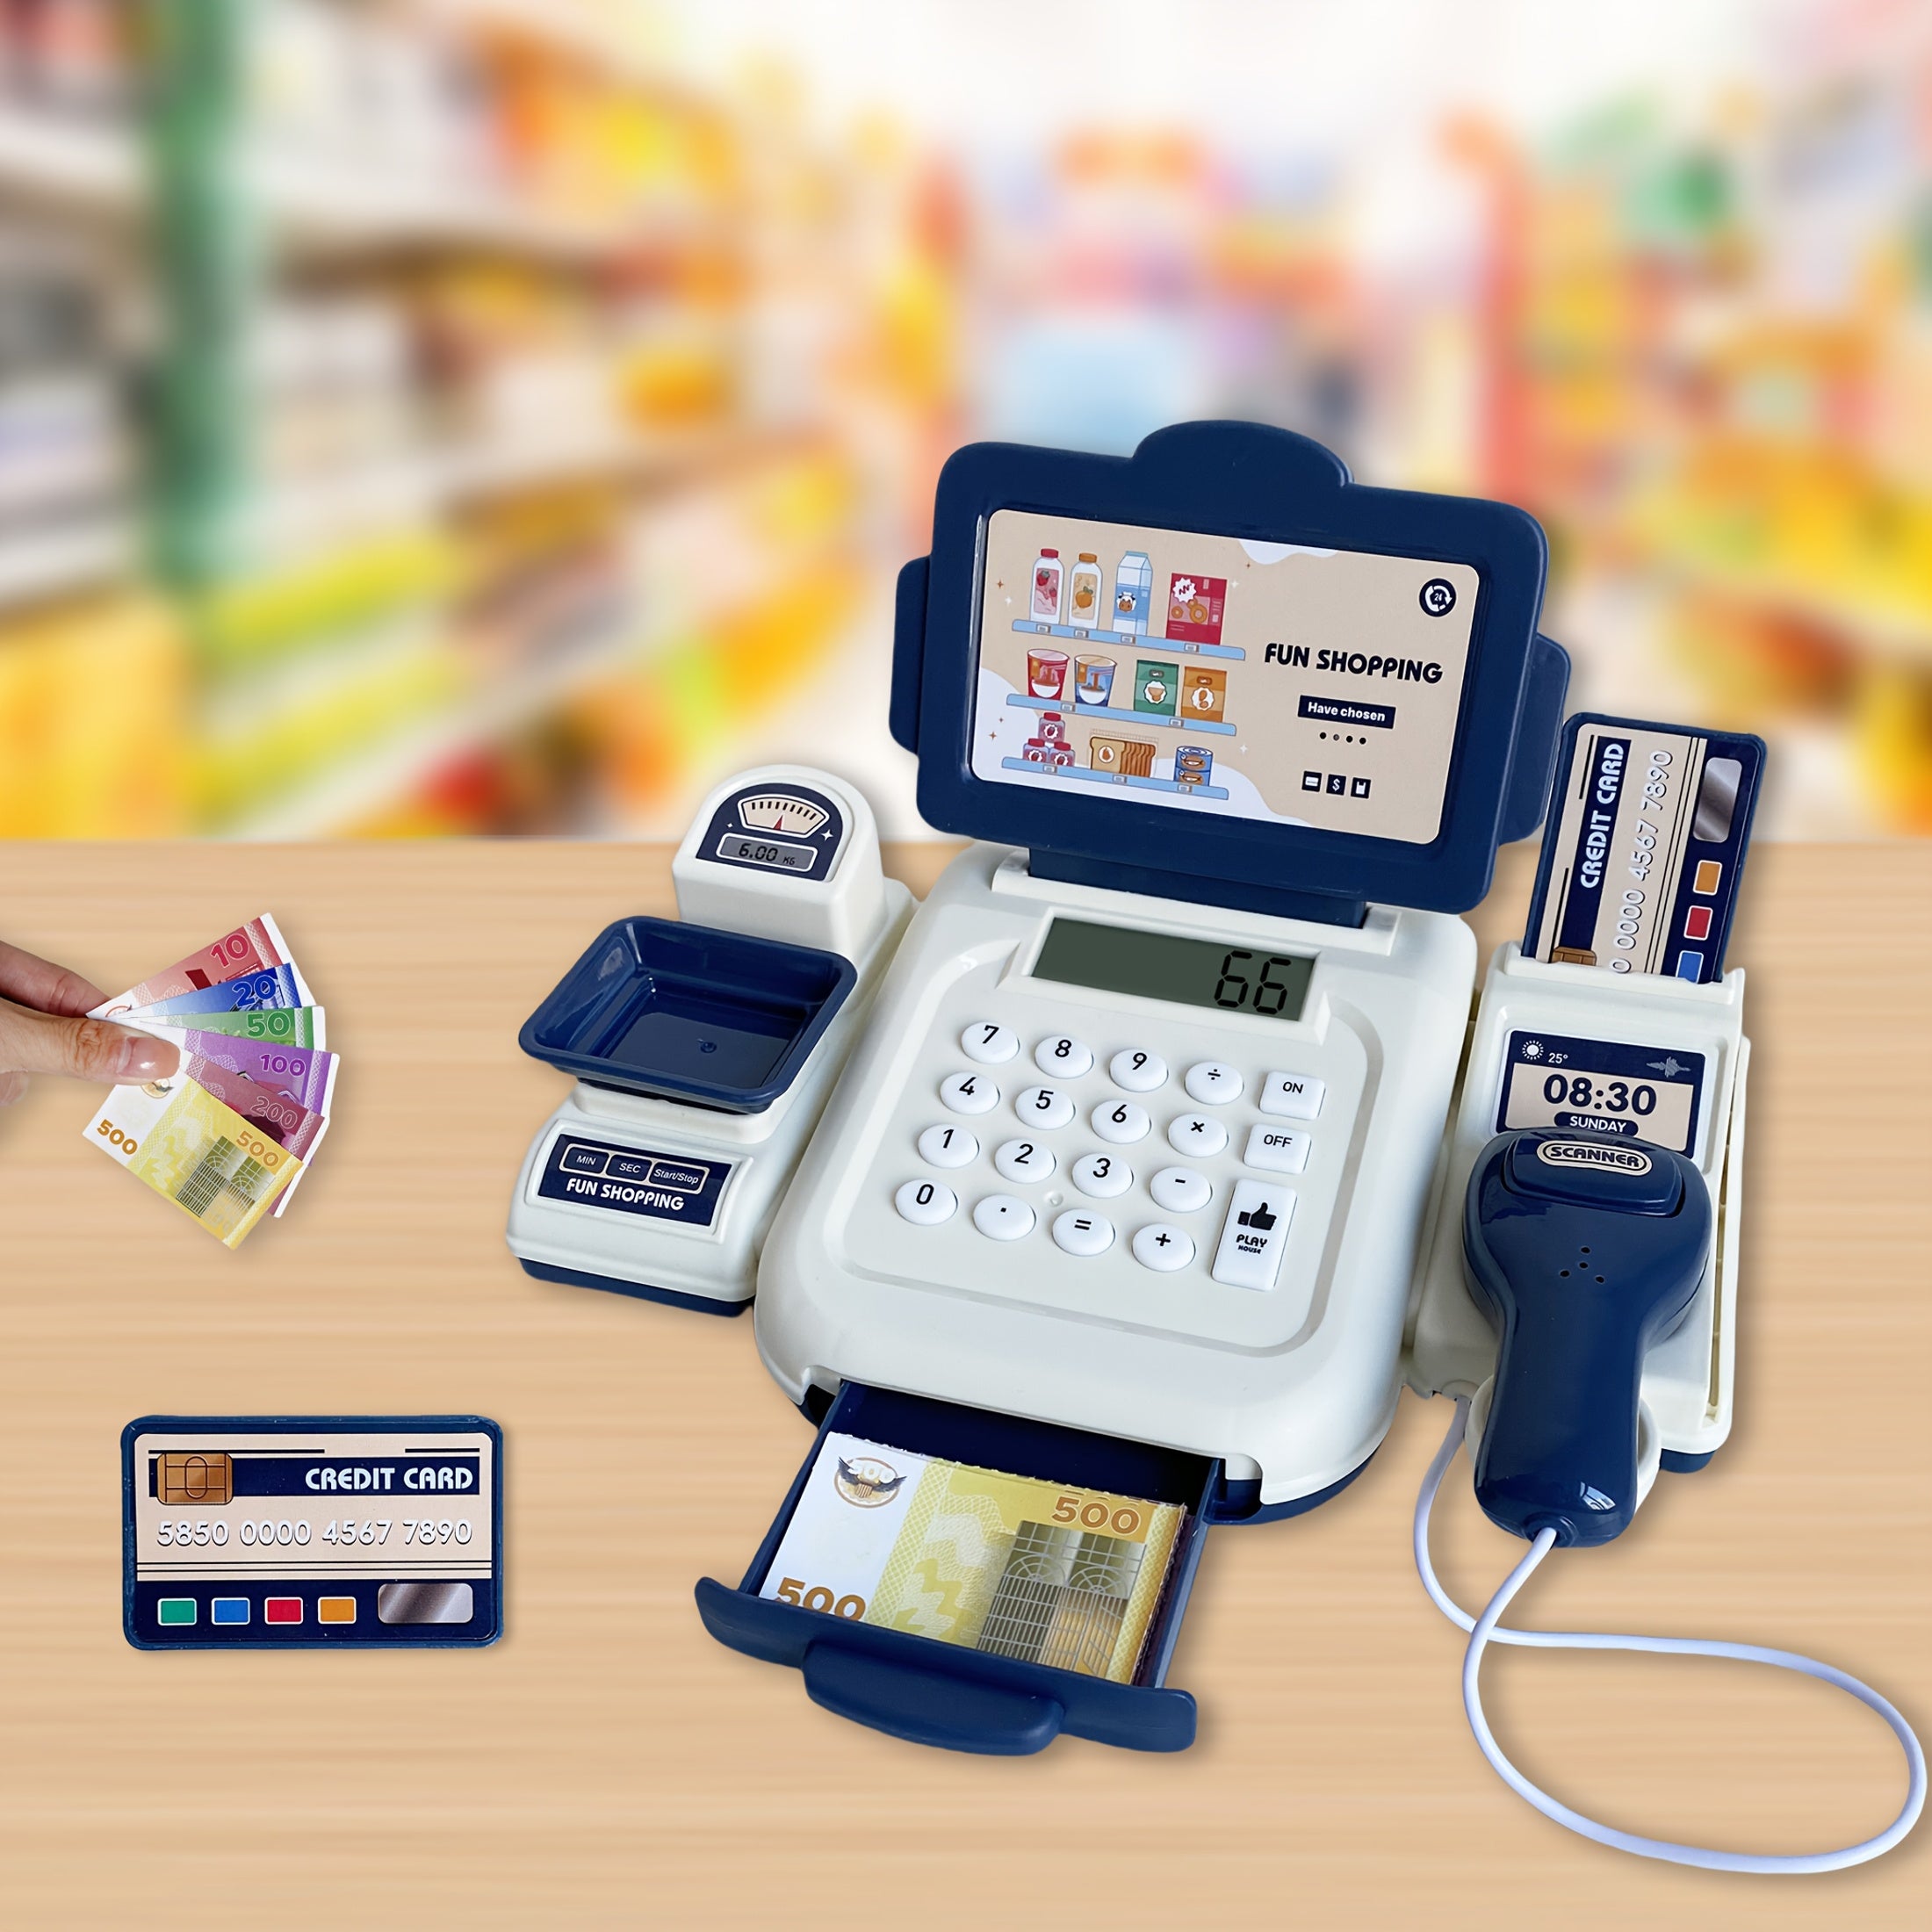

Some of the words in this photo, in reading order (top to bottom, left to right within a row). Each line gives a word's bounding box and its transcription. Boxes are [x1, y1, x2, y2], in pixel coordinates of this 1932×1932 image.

[1433, 592, 1443, 602] 24
[1265, 643, 1310, 668] FUN
[1316, 649, 1443, 683] SHOPPING
[1308, 702, 1338, 716] Have
[1340, 707, 1386, 722] chosen
[1639, 750, 1673, 811] 7890
[1580, 810, 1612, 889] CREDIT
[1596, 743, 1625, 804] CARD
[739, 842, 778, 862] 6.00
[782, 856, 796, 866] KG
[1628, 818, 1659, 882] 4567
[1613, 888, 1646, 950] 0000
[210, 933, 250, 968] 10
[232, 974, 277, 1007] 20
[1213, 949, 1292, 1015] 66
[246, 1012, 291, 1038] 50
[981, 1025, 999, 1044] 7
[1054, 1039, 1072, 1058] 8
[260, 1054, 306, 1078] 100
[1132, 1052, 1147, 1071] 9
[959, 1077, 977, 1096] 4
[1282, 1081, 1304, 1095] ON
[1543, 1073, 1657, 1115] 08:30
[1035, 1090, 1054, 1110] 5
[250, 1096, 299, 1130] 200
[1111, 1104, 1128, 1123] 6
[1569, 1115, 1627, 1133] SUNDAY
[97, 1119, 138, 1157] 500
[235, 1129, 279, 1168] 500
[941, 1128, 955, 1149] 1
[1263, 1134, 1293, 1149] OFF
[576, 1155, 596, 1166] MIN
[1014, 1143, 1034, 1164] 2
[1550, 1146, 1640, 1168] SCANNER
[618, 1163, 642, 1173] SEC
[653, 1169, 699, 1185] Start/Stop
[1092, 1157, 1111, 1179] 3
[566, 1178, 599, 1196] FUN
[601, 1184, 684, 1211] SHOPPING
[916, 1184, 934, 1205] 0
[1236, 1233, 1268, 1248] PLAY
[1237, 1244, 1262, 1255] HOUSE
[305, 1467, 396, 1491] CREDIT
[403, 1466, 473, 1490] CARD
[1051, 1496, 1140, 1534] 500
[156, 1519, 230, 1546] 5850
[239, 1519, 312, 1546] 0000
[321, 1518, 393, 1546] 4567
[403, 1517, 472, 1545] 7890
[774, 1576, 867, 1622] 500
